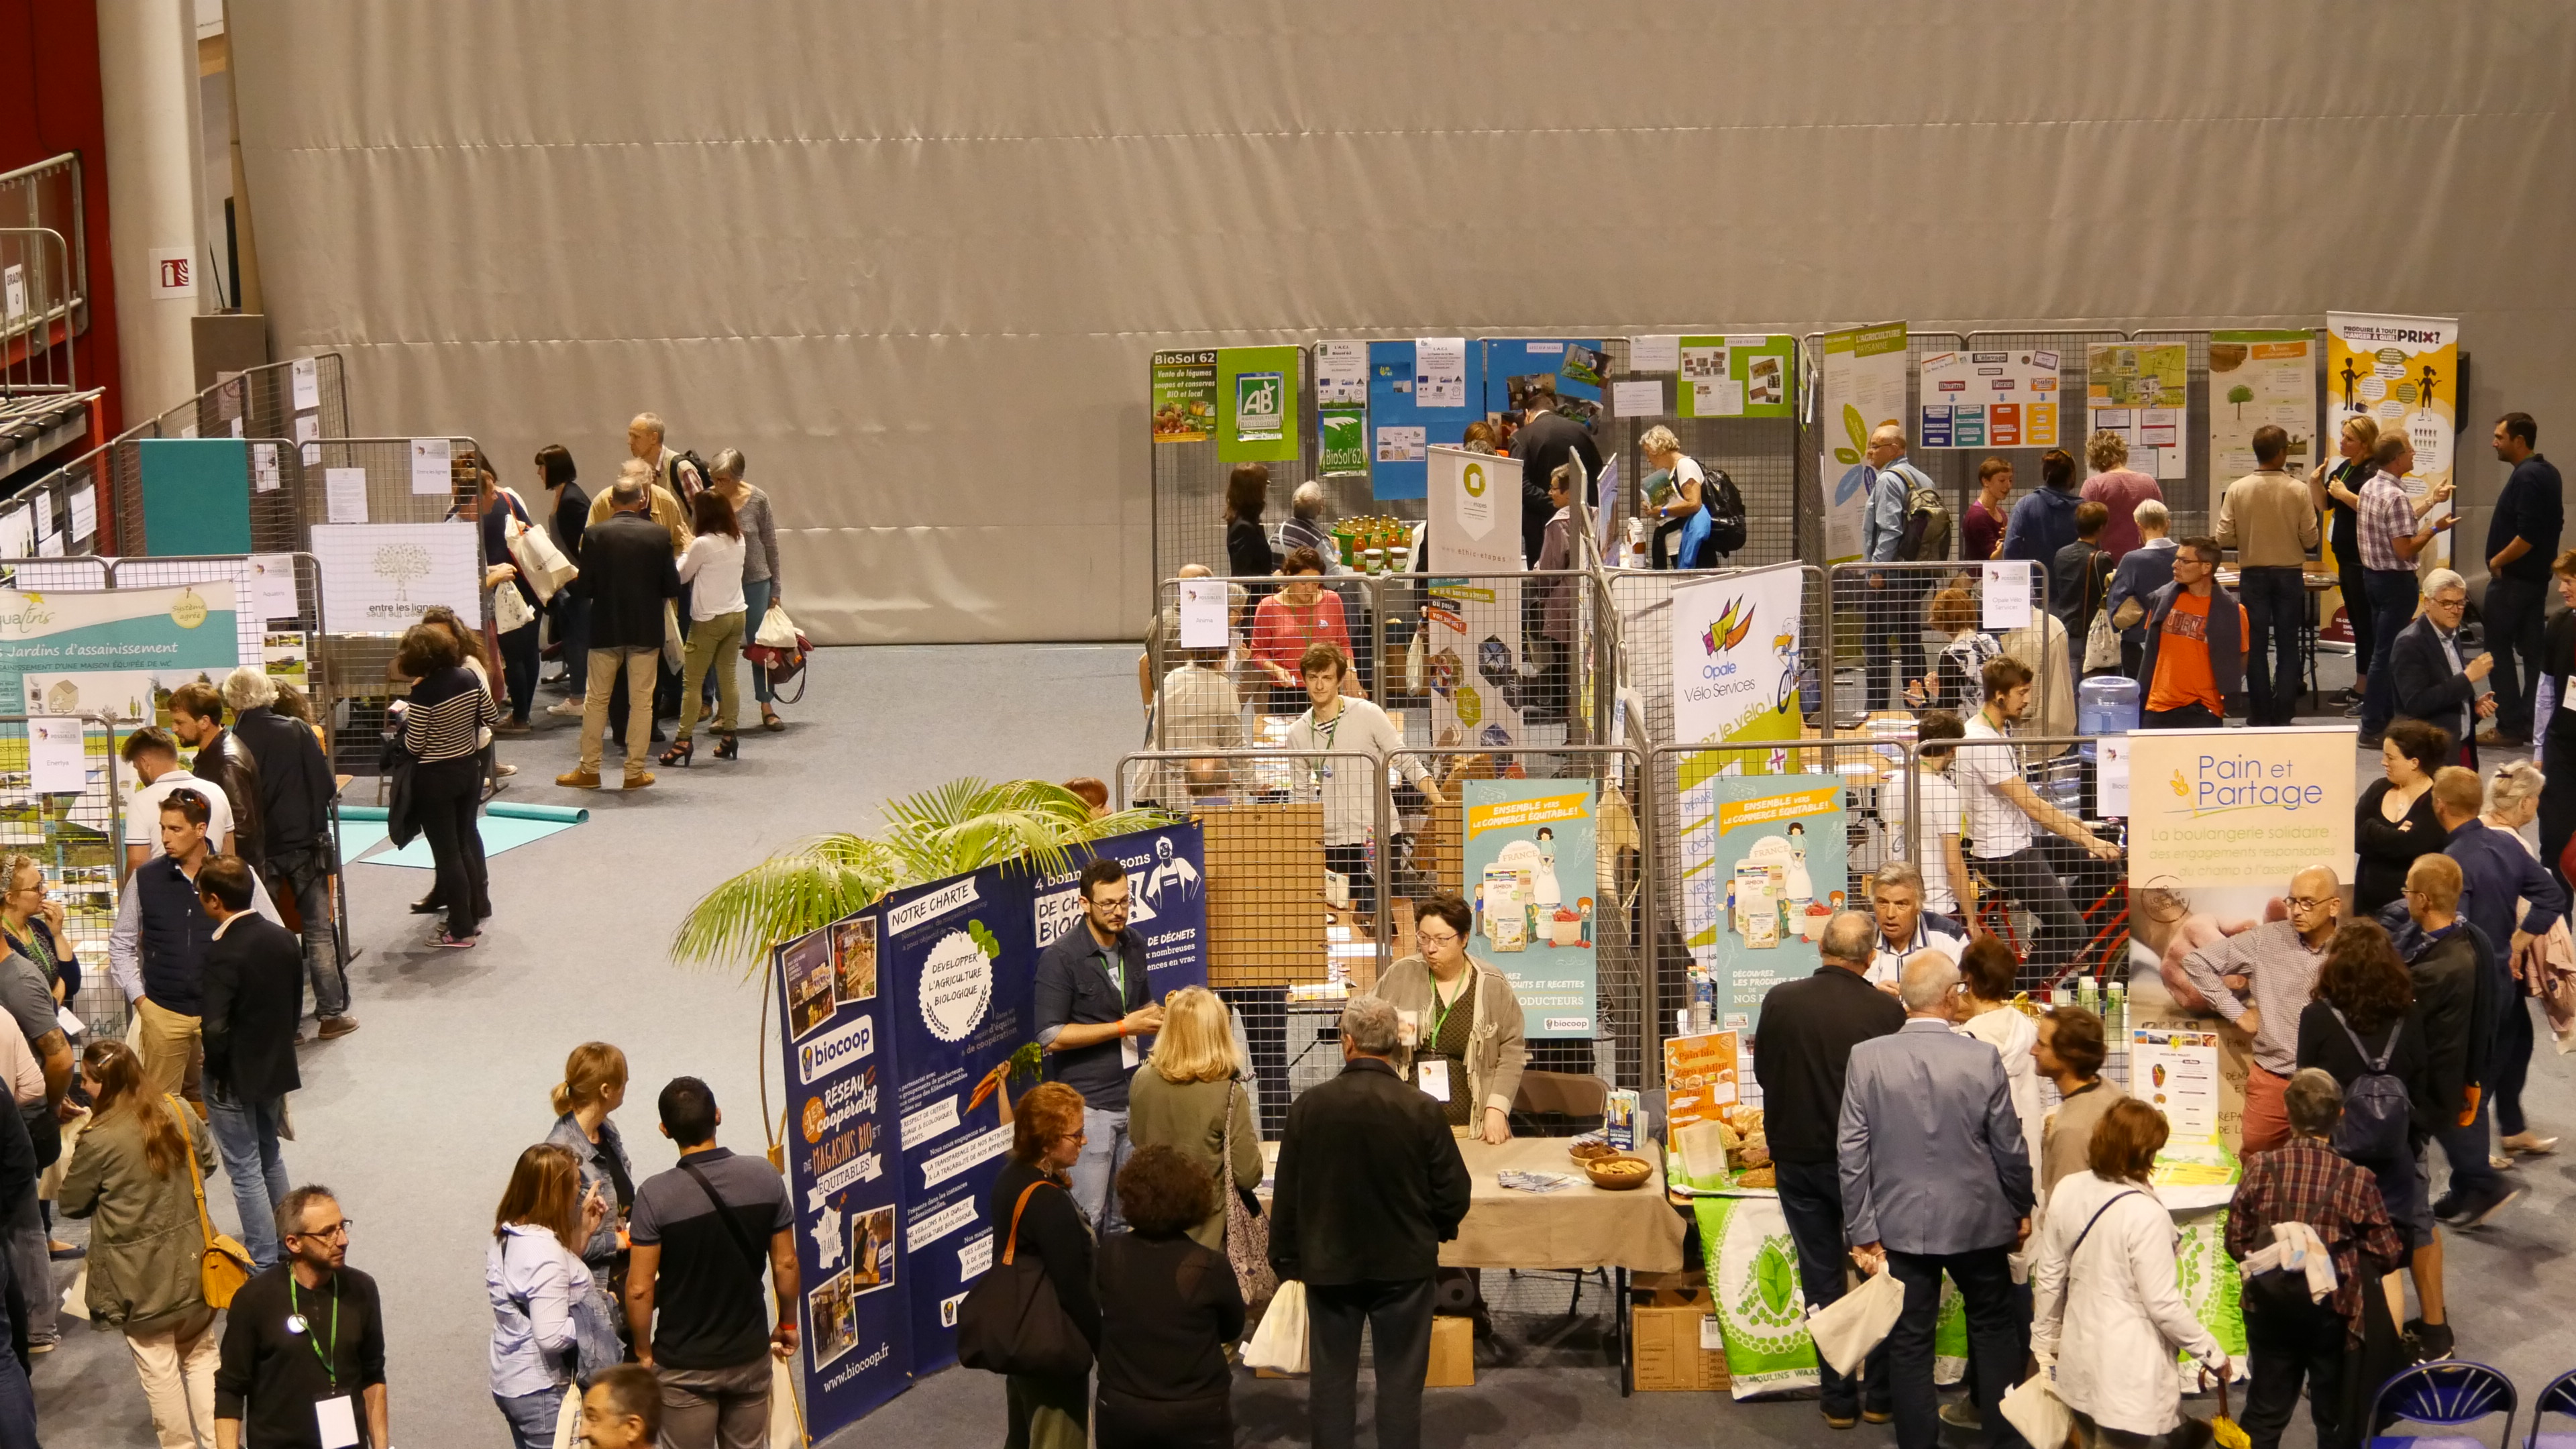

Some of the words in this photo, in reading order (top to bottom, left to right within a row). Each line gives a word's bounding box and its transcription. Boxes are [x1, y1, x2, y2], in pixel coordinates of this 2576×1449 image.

[1856, 329, 1900, 343] L'AGRICULTURE
[1155, 354, 1195, 364] BioSol
[1199, 353, 1215, 362] 62
[1186, 370, 1212, 378] légumes
[1243, 390, 1273, 413] AB
[396, 604, 410, 612] les
[7, 644, 60, 657] Jardins
[65, 642, 178, 656] d'assainissement
[1703, 661, 1737, 680] Opale
[1684, 686, 1711, 702] Vélo
[1713, 679, 1756, 698] Services
[1735, 702, 1765, 727] vélo
[2198, 754, 2261, 779] Pain
[2271, 759, 2293, 777] et
[2198, 780, 2322, 810] Partage
[1493, 801, 1542, 816] ENSEMBLE
[1543, 801, 1560, 809] VERS
[1744, 797, 1791, 811] ENSEMBLE
[1482, 814, 1526, 828] COMMERCE
[1733, 809, 1777, 823] COMMERCE
[2151, 828, 2169, 841] La
[2174, 824, 2263, 843] boulangerie
[2268, 824, 2329, 840] solidaire
[1503, 849, 1538, 862] FRANCE
[1754, 845, 1788, 858] FRANCE
[2149, 847, 2171, 859] des
[2174, 847, 2257, 863] engagements
[2259, 846, 2336, 860] responsables
[1034, 878, 1044, 891] 4
[892, 901, 926, 927] NOTRE
[929, 883, 969, 912] CHARTE
[1039, 902, 1057, 918] DE
[901, 929, 916, 940] Notre
[1148, 936, 1160, 947] DE
[1161, 928, 1195, 944] DÉCHETS
[1151, 943, 1195, 959] nombreuses
[932, 953, 978, 974] DÉVELOPPER
[1146, 961, 1168, 971] ences
[1169, 959, 1178, 967] en
[1179, 955, 1195, 965] vrac
[928, 967, 982, 991] L'AGRICULTURE
[1733, 969, 1774, 977] DÉCOUVREZ
[1548, 980, 1585, 989] RECETTES
[934, 984, 978, 1007] BIOLOGIQUE
[1518, 996, 1584, 1006] ODUCTEURS
[1733, 995, 1756, 1004] NOS
[989, 1016, 1017, 1033] d'équité
[1554, 1019, 1587, 1028] biocoop
[815, 1027, 870, 1067] biocoop
[966, 1044, 975, 1054] de
[976, 1026, 1018, 1049] coopération
[1679, 1051, 1699, 1061] Pain
[1701, 1049, 1715, 1057] bio
[824, 1073, 865, 1109] RÉSEAU
[1686, 1089, 1706, 1097] Pain
[816, 1084, 878, 1133] coopératif
[904, 1114, 922, 1128] RESPECT
[803, 1159, 812, 1173] DE
[812, 1130, 856, 1177] MAGASINS
[858, 1121, 873, 1153] BIO
[872, 1124, 881, 1139] ET
[927, 1164, 934, 1172] LA
[934, 1146, 969, 1169] TRANSPARENCE
[977, 1138, 987, 1148] NOS
[930, 1148, 940, 1157] Nous
[977, 1148, 987, 1158] NOS
[818, 1157, 871, 1195] ÉQUITABLES
[908, 1202, 927, 1216] Présents
[824, 1215, 833, 1234] EN
[914, 1220, 938, 1234] VEILLONS
[909, 1225, 944, 1248] L'AGRICULTURE
[964, 1236, 973, 1244] Nos
[820, 1232, 840, 1257] FRANCE
[965, 1248, 974, 1256] DES
[975, 1241, 987, 1252] LIEUX
[823, 1342, 890, 1393] www.biocoop.fr
[1749, 1371, 1790, 1382] MOULINS
